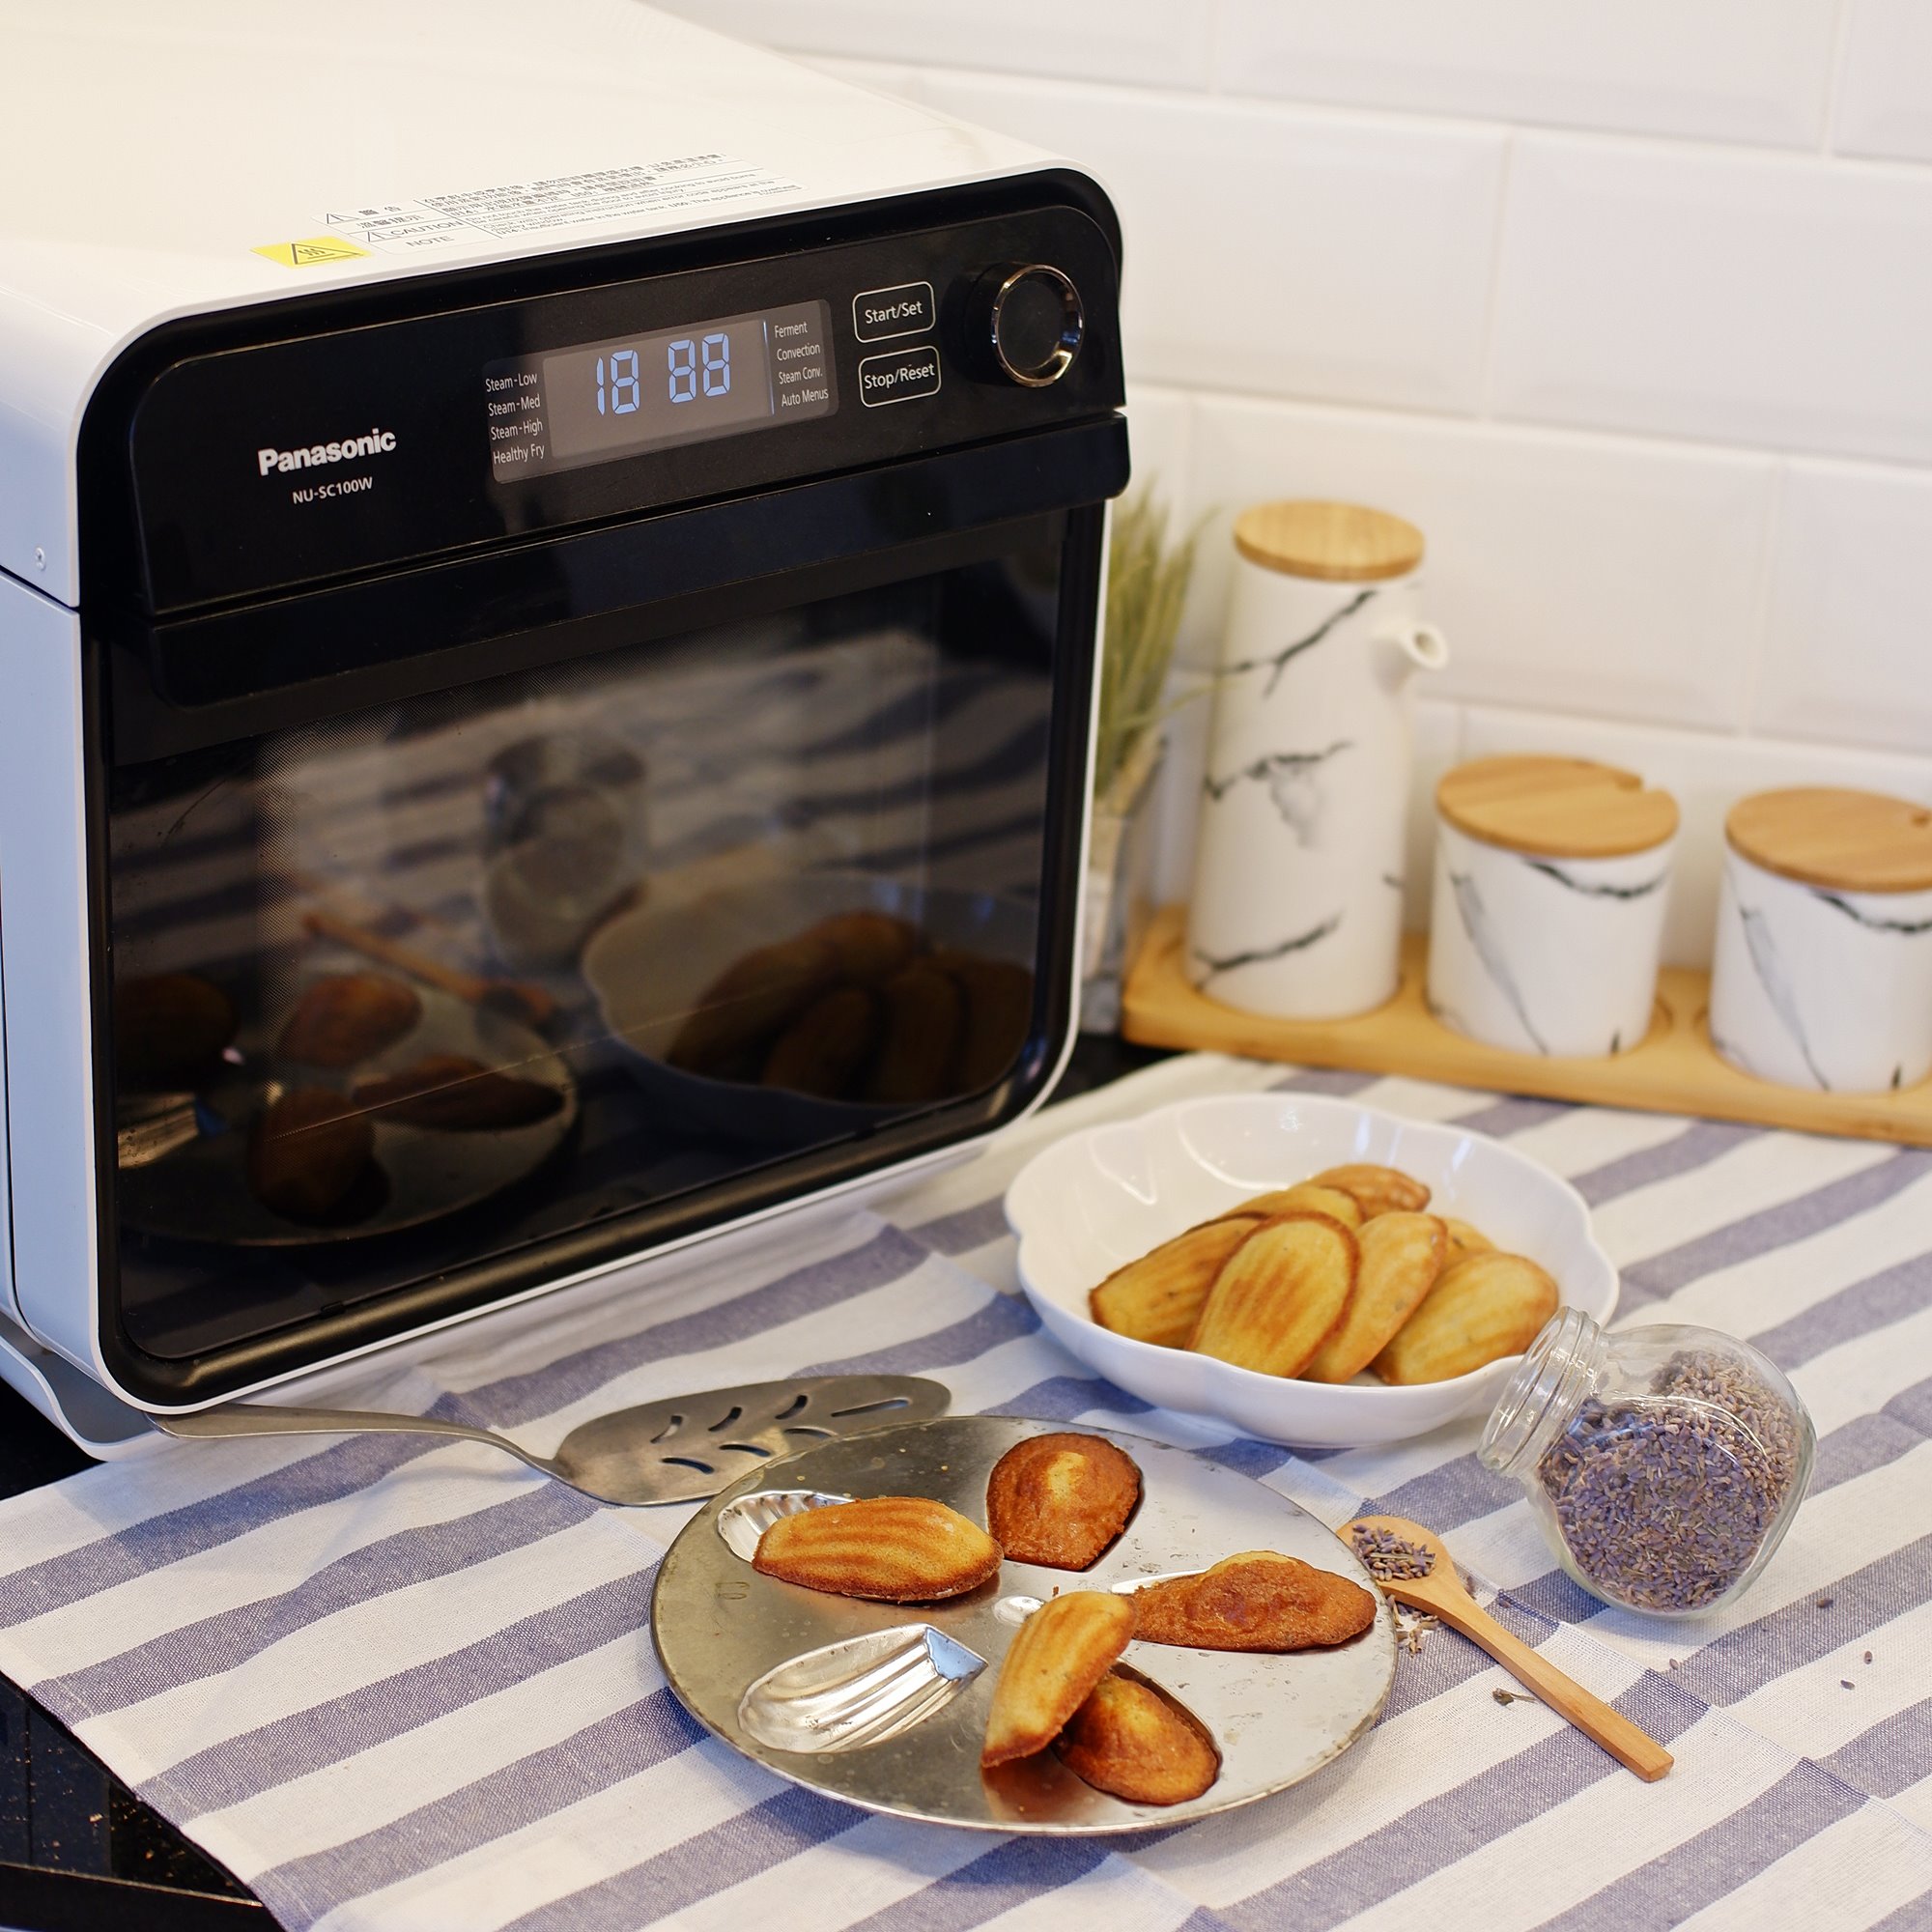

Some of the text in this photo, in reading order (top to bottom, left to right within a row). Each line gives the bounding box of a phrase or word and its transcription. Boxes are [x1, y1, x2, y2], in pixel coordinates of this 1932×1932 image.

[391, 221, 464, 236] CAUTION
[406, 236, 455, 247] NOTE
[865, 301, 923, 325] Start/Set
[774, 322, 808, 338] Ferment
[777, 343, 821, 360] Convection
[779, 367, 823, 385] Steam Conv.
[864, 363, 935, 390] Stop/Reset
[781, 387, 829, 407] Auto Menus
[258, 428, 396, 476] Panasonic
[493, 443, 545, 466] Healthy Fry
[293, 476, 373, 504] NU-SC100W
